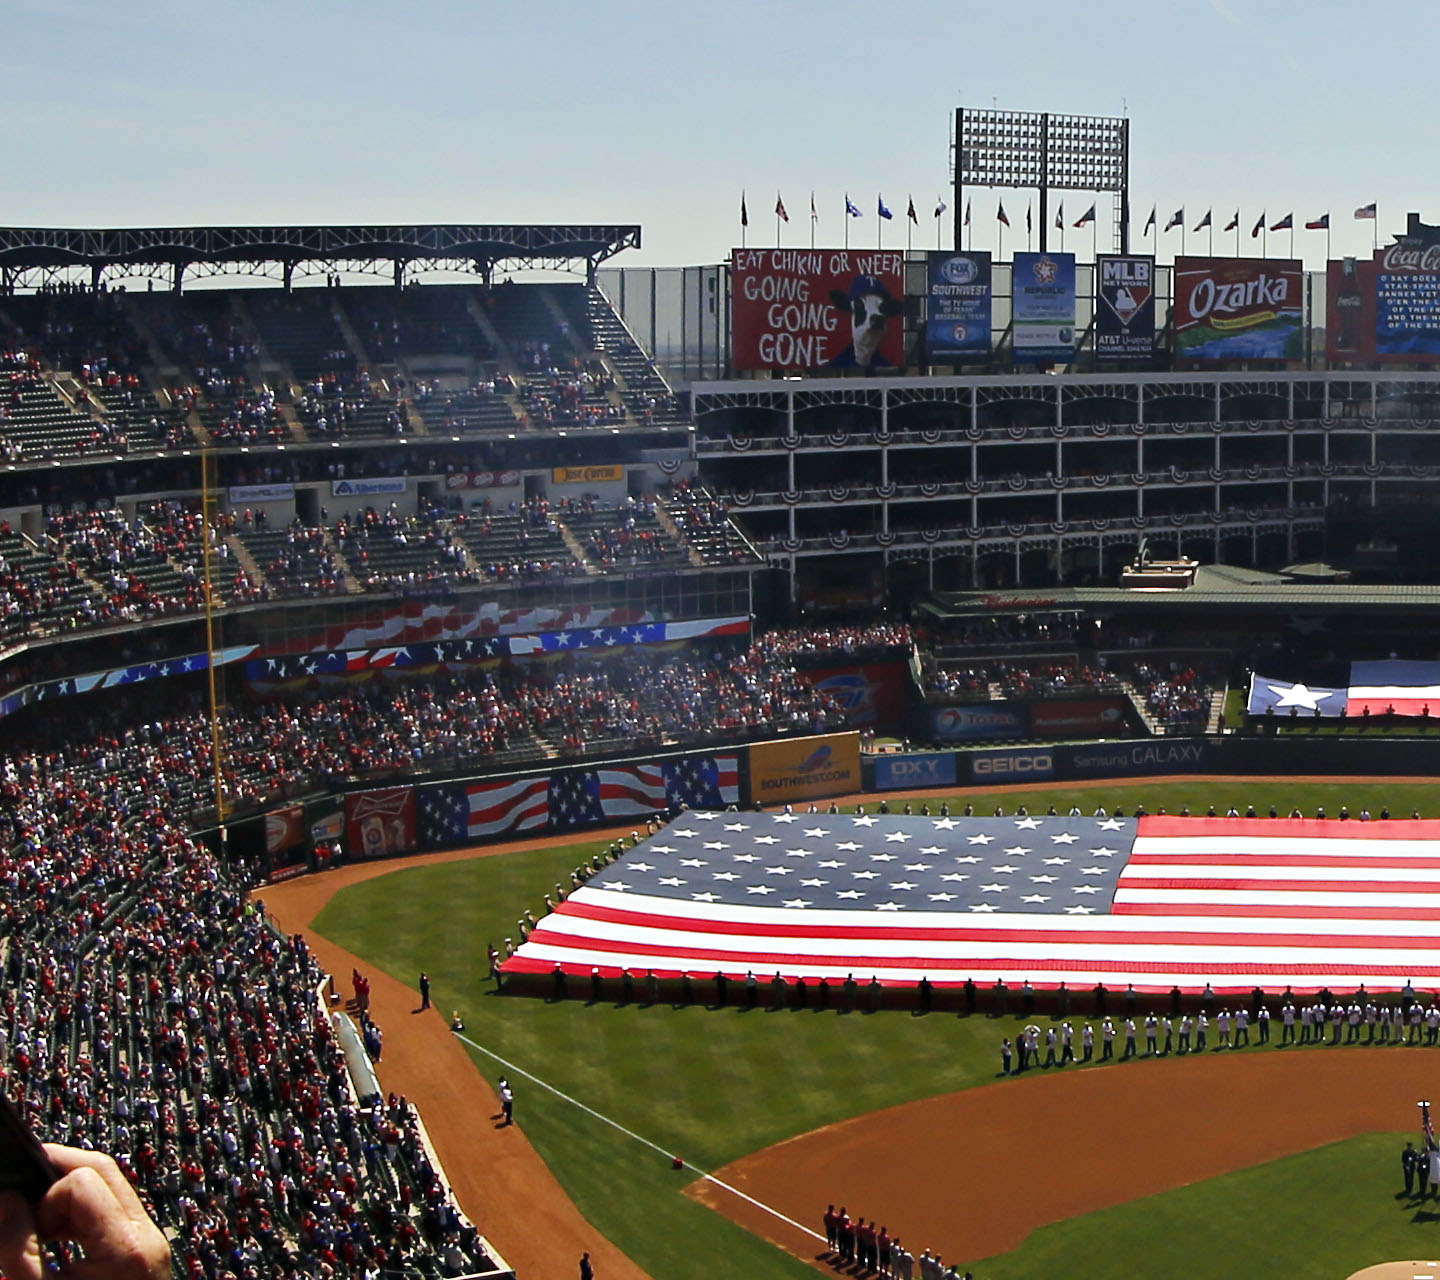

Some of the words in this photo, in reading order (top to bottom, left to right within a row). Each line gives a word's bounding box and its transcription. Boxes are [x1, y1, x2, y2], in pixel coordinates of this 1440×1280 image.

[736, 251, 767, 270] EAT
[771, 250, 822, 275] CHIKIN
[830, 252, 851, 276] OR
[856, 254, 902, 277] WEER
[1103, 262, 1149, 280] MLB
[744, 276, 810, 302] GOING
[932, 285, 988, 296] SOUTHWEST
[1189, 274, 1288, 318] Ozarka
[767, 303, 838, 332] GOING
[759, 333, 829, 367] GONE
[1098, 335, 1120, 344] AT&T
[891, 759, 939, 775] OXY
[973, 755, 1053, 772] GEICO
[1073, 755, 1128, 769] Samsung
[1132, 745, 1203, 764] GALAXY
[761, 769, 851, 790] SOUTHWEST.COM
